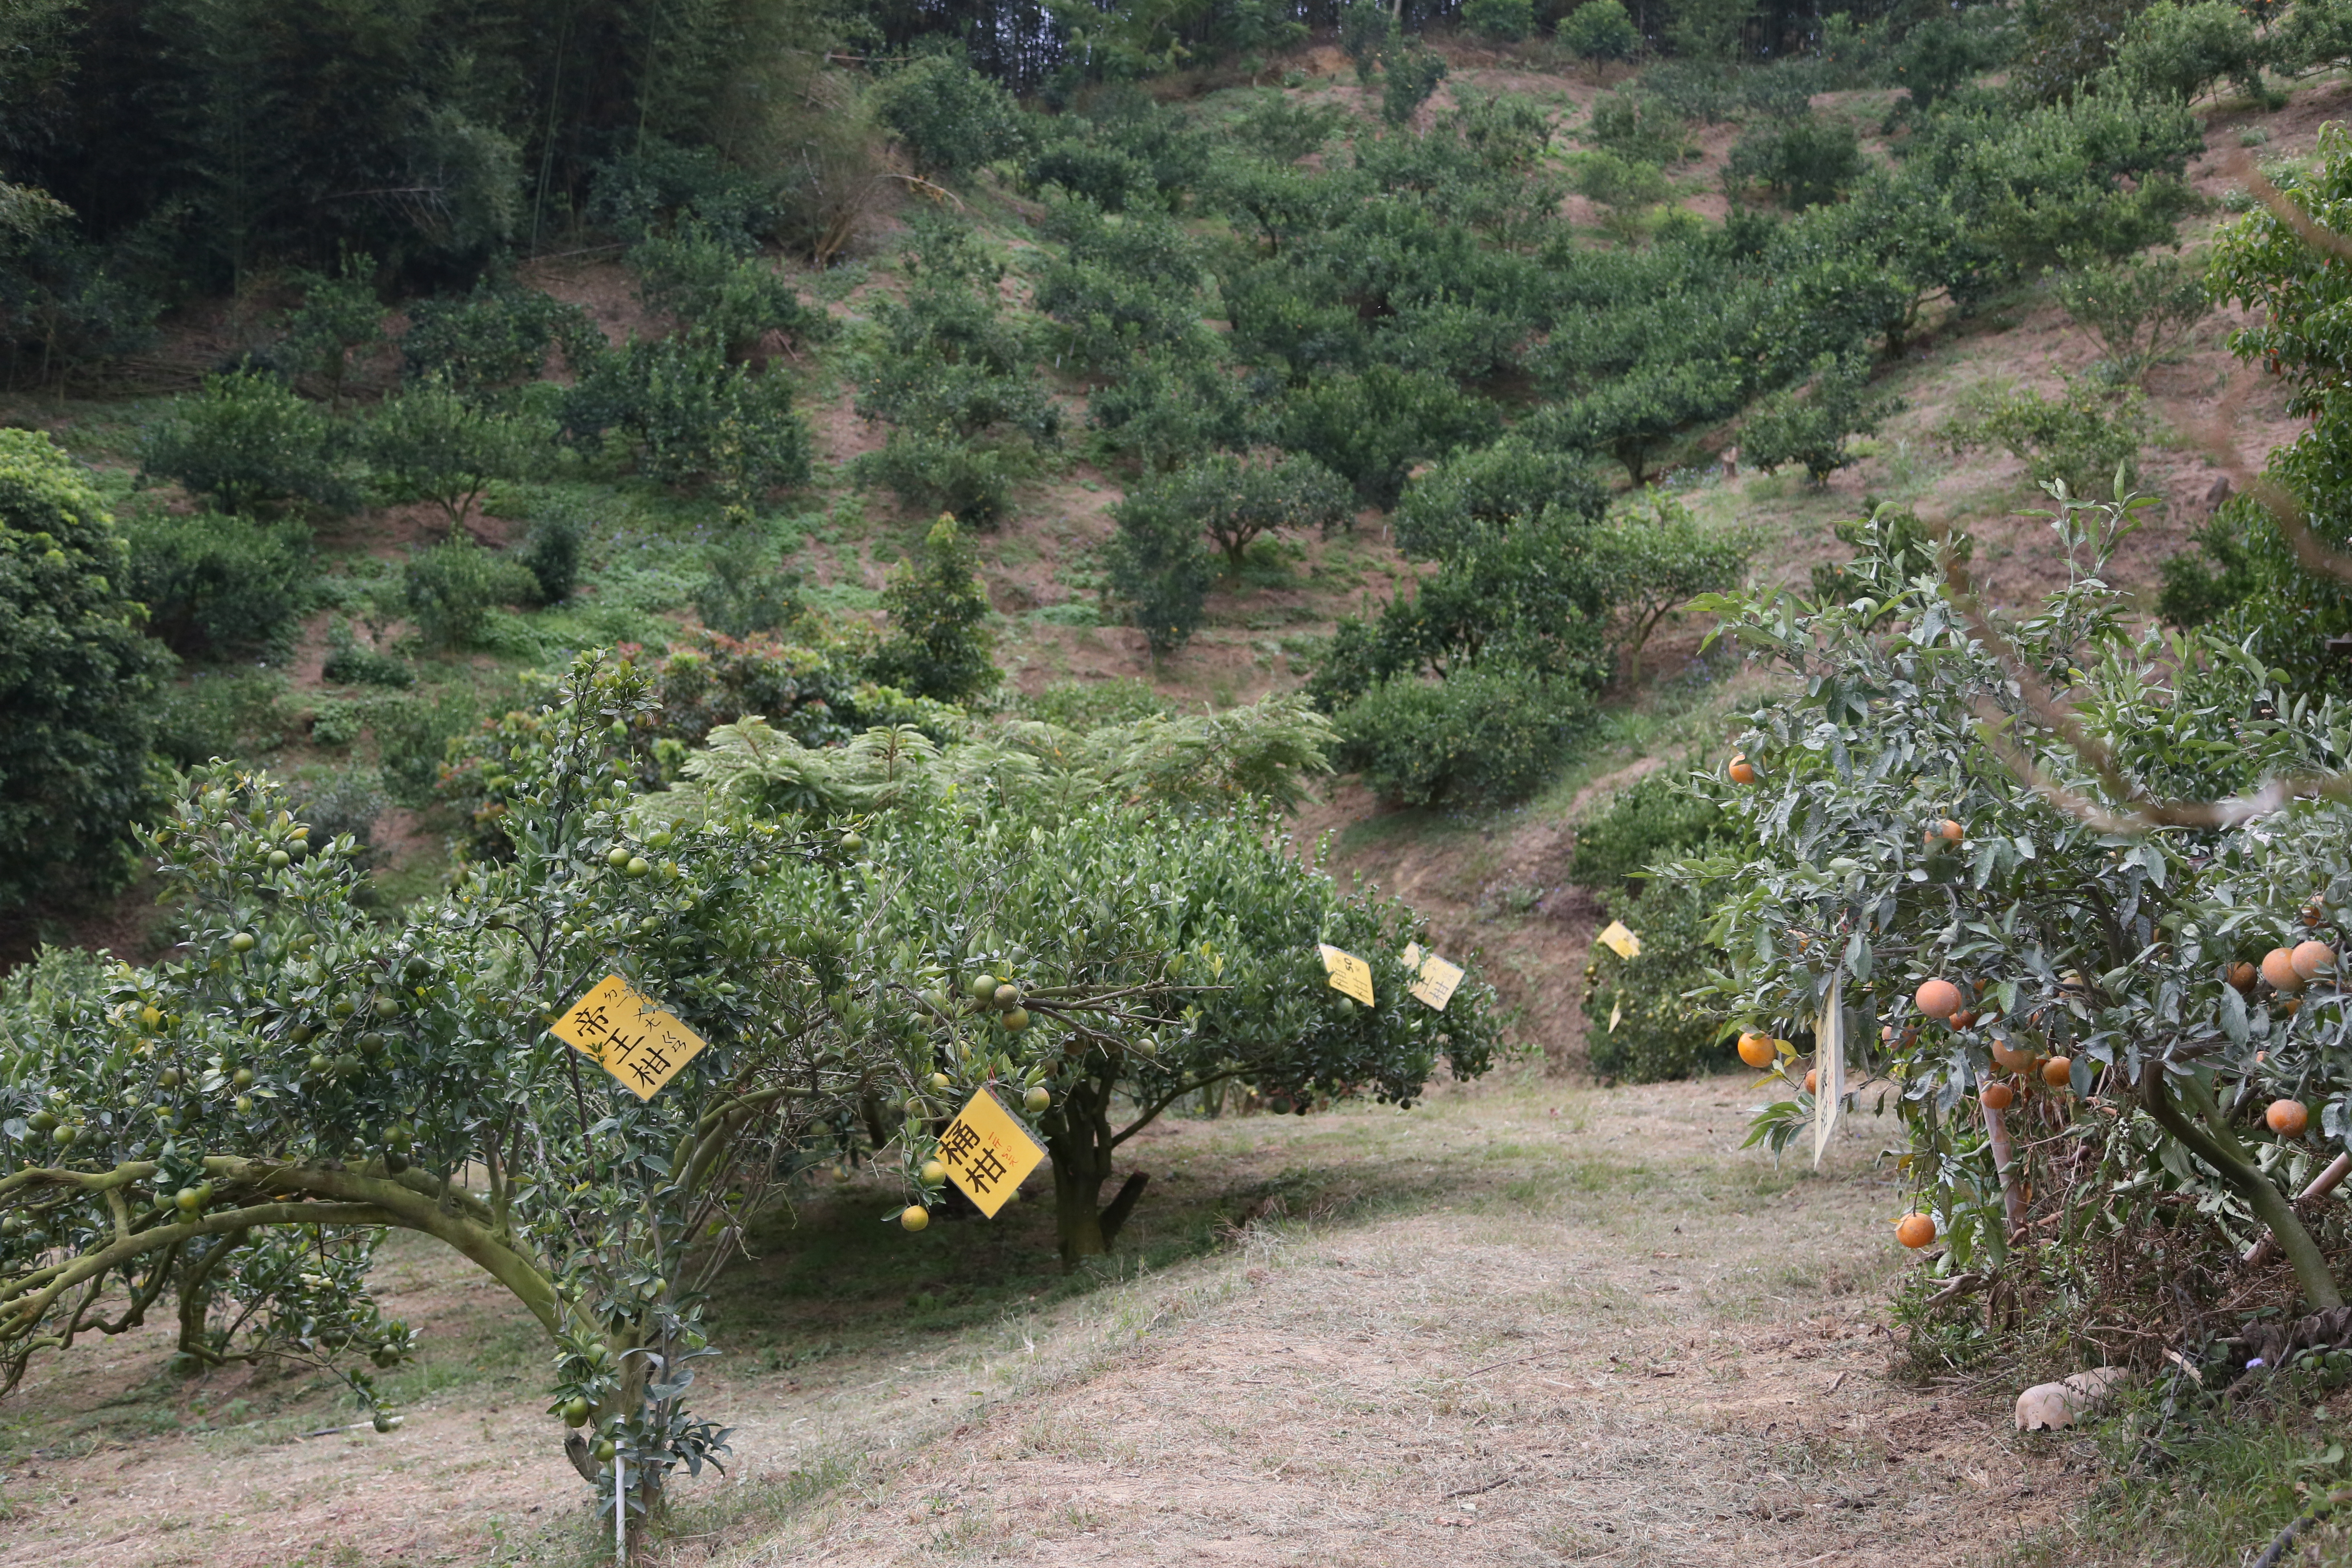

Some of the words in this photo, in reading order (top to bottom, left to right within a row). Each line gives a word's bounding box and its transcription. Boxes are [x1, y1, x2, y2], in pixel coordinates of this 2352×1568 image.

[573, 1006, 671, 1089] 帝王柑
[940, 1119, 1007, 1194] 桶柑
